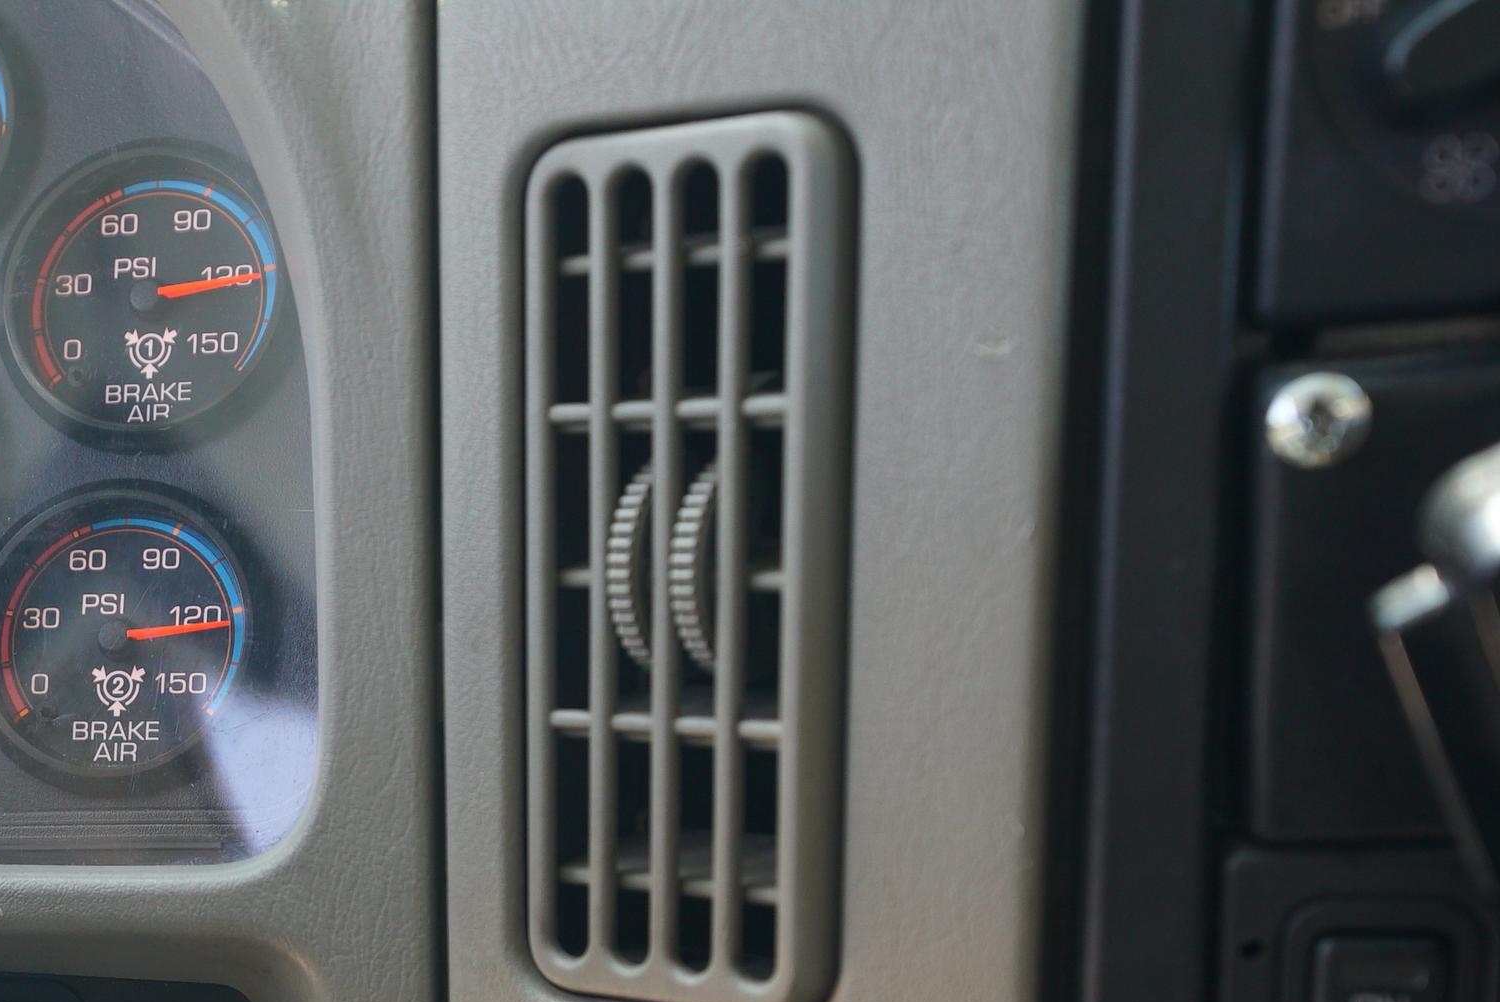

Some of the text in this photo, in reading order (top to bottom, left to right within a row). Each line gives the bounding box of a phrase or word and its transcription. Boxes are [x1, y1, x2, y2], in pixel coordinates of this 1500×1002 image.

[101, 214, 138, 237] 60
[173, 209, 212, 232] 90
[114, 257, 158, 280] PSI
[201, 264, 253, 286] 120
[55, 274, 92, 296] 30
[63, 339, 82, 360] 0
[187, 331, 239, 355] 150
[105, 381, 192, 405] BRAKE
[127, 403, 170, 423] AIR
[68, 549, 108, 572] 60
[142, 548, 181, 571] 90
[81, 593, 126, 615] PSI
[23, 607, 60, 629] 30
[169, 605, 222, 626] 120
[31, 673, 49, 695] 0
[155, 671, 208, 695] 150
[72, 720, 160, 742] BRAKE
[93, 742, 138, 763] AIR
